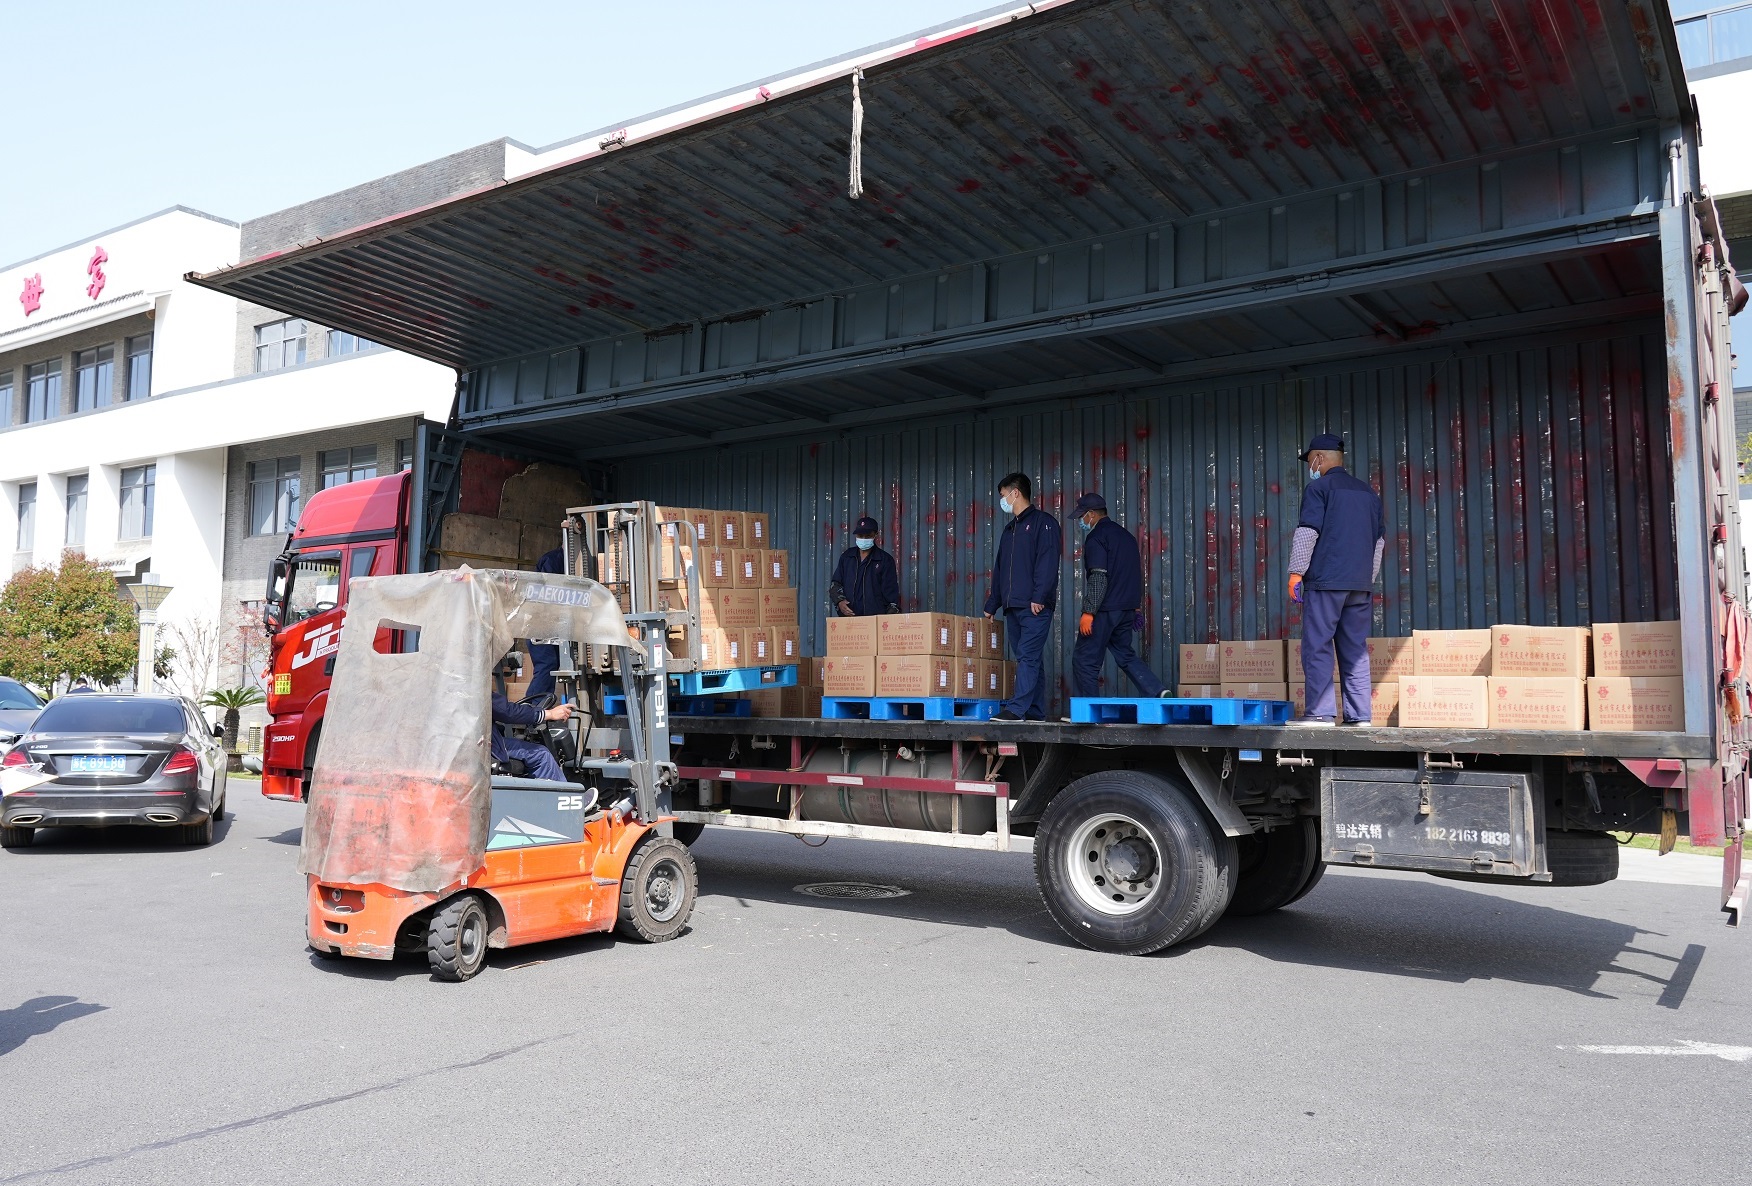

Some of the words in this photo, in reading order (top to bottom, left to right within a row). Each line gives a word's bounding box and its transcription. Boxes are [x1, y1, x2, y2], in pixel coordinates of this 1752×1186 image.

[653, 675, 666, 729] HELI
[557, 795, 583, 811] 25
[1425, 827, 1447, 840] 182
[1449, 829, 1478, 843] 2163
